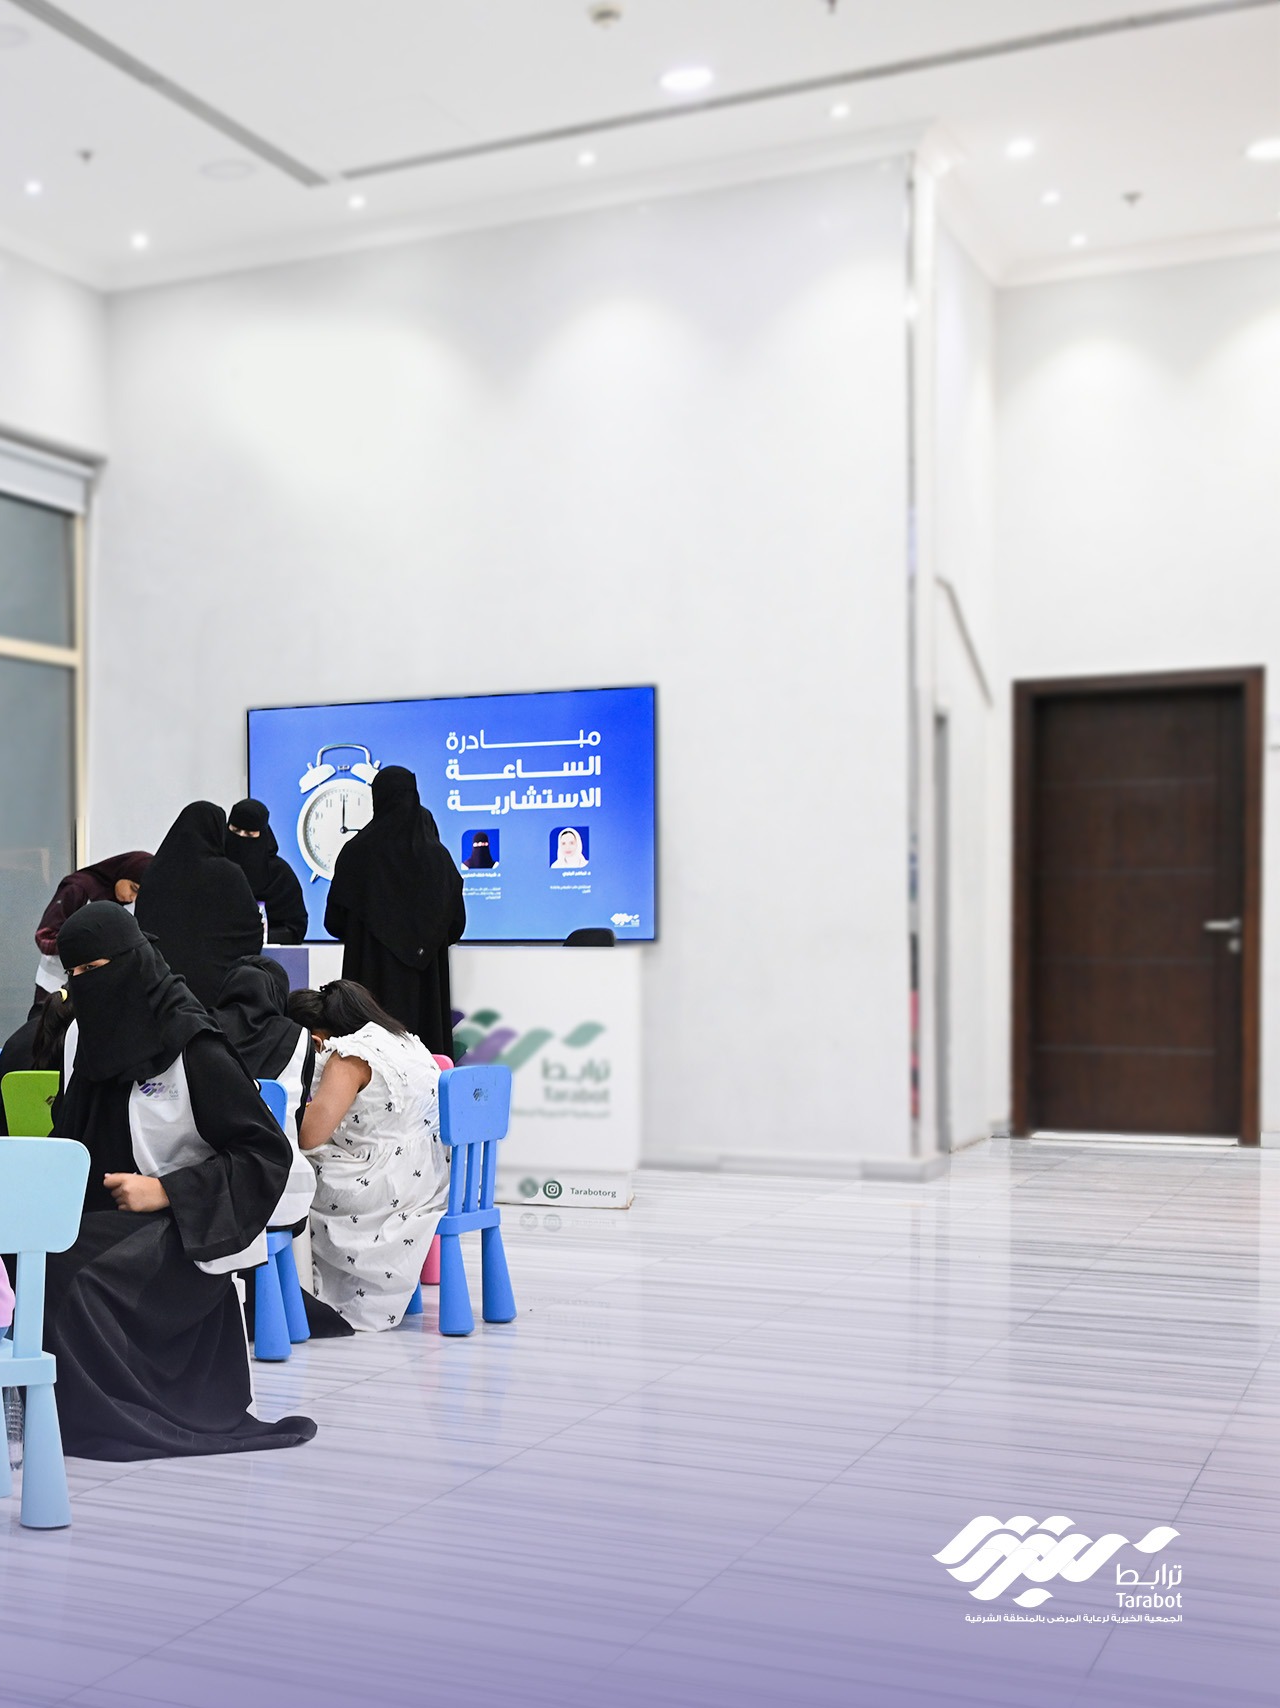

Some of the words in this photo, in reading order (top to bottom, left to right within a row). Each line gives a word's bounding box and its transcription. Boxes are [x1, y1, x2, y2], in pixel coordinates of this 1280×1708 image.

[445, 729, 602, 754] مبادرة
[445, 755, 602, 781] الساعة
[446, 785, 602, 815] الاستشارية
[570, 1187, 617, 1198] Tarabotorg
